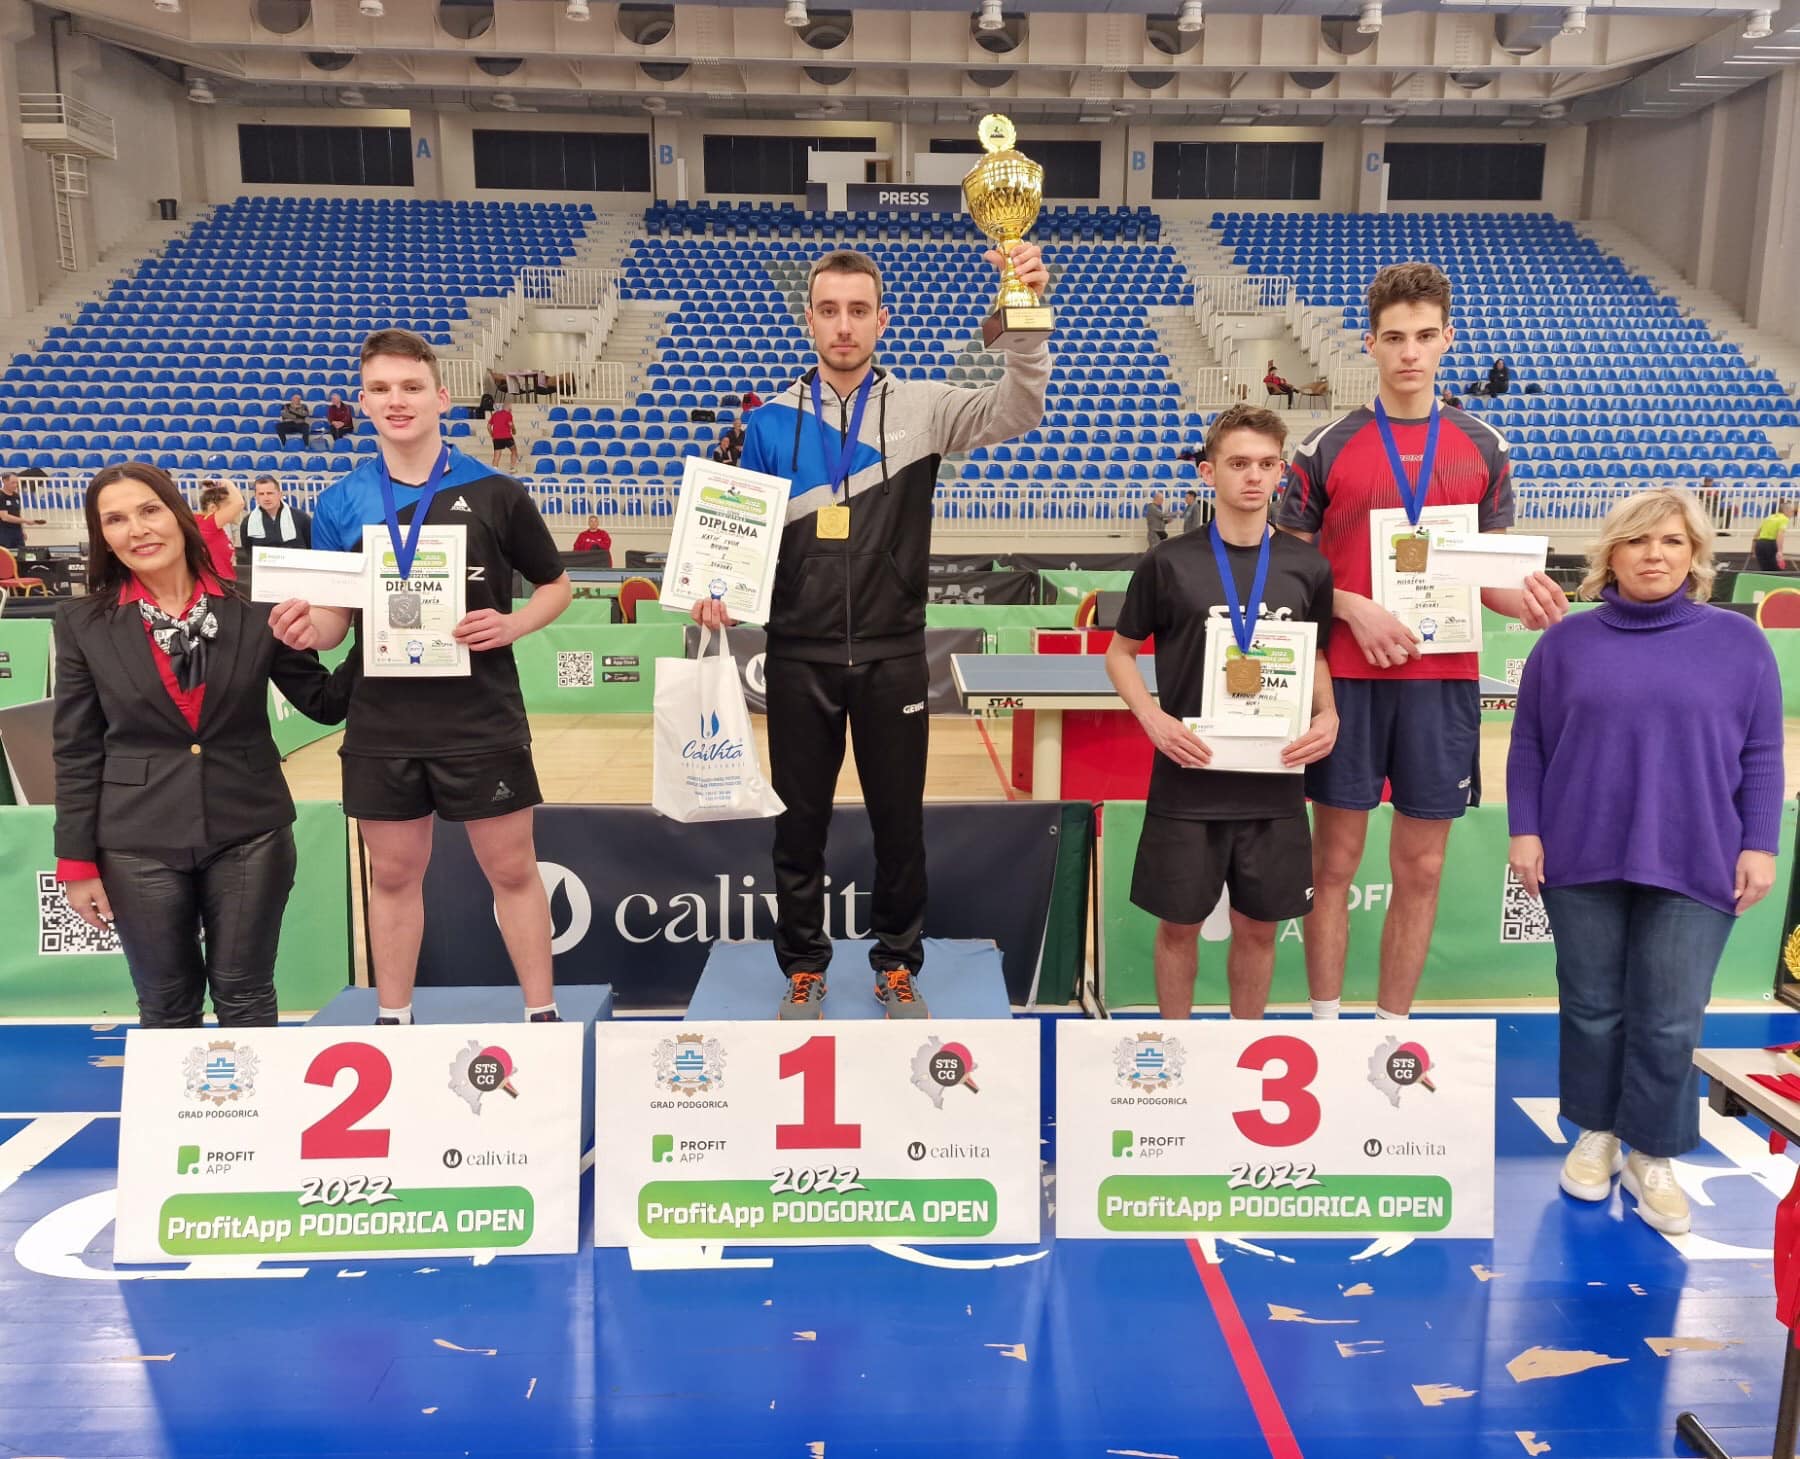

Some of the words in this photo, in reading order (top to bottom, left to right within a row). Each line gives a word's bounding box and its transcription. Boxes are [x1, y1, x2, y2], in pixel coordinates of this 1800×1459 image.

[416, 138, 432, 158] A
[659, 145, 673, 164] B
[1132, 151, 1146, 170] B
[1365, 152, 1380, 172] C
[879, 192, 929, 205] PRESS
[531, 421, 540, 429] VI
[524, 437, 530, 445] V
[876, 429, 906, 443] GWO
[698, 514, 759, 539] DIPLOMA
[927, 584, 985, 604] TAG
[988, 697, 1024, 708] STAG
[1481, 698, 1517, 710] STAG
[614, 873, 874, 944] caliit
[475, 1063, 497, 1074] STS
[935, 1059, 958, 1070] STS
[1392, 1058, 1415, 1069] STS
[476, 1075, 495, 1085] CG
[937, 1070, 956, 1081] CG
[1394, 1069, 1413, 1080] CG
[776, 1035, 861, 1149] 1
[1232, 1034, 1321, 1147] 3
[300, 1041, 393, 1160] 2
[650, 1101, 675, 1109] GRAD
[677, 1100, 728, 1109] PODGORICA
[1110, 1097, 1135, 1105] GRAD
[1137, 1097, 1188, 1105] PODGORICA
[178, 1110, 203, 1119] GRAD
[205, 1109, 259, 1119] PODGORICA
[680, 1140, 727, 1151] PROFIT
[1140, 1136, 1186, 1147] PROFIT
[1386, 1140, 1446, 1156] calivita
[207, 1151, 255, 1162] PROFIT
[930, 1143, 990, 1159] calivita
[1140, 1148, 1164, 1158] APP
[467, 1151, 528, 1166] calivita
[680, 1153, 704, 1163] APP
[206, 1163, 232, 1175] APP
[1226, 1161, 1327, 1190] 2022
[768, 1164, 870, 1195] 2022
[299, 1175, 402, 1207] 2022
[647, 1202, 764, 1229] ProfitApp
[772, 1200, 916, 1224] PODGORICA
[923, 1200, 989, 1223] OPEN
[1106, 1196, 1222, 1222] ProfitApp
[1230, 1195, 1372, 1218] PODGORICA
[1378, 1196, 1444, 1218] OPEN
[168, 1214, 292, 1243] ProfitApp
[300, 1210, 449, 1237] PODGORICA
[457, 1208, 525, 1233] OPEN
